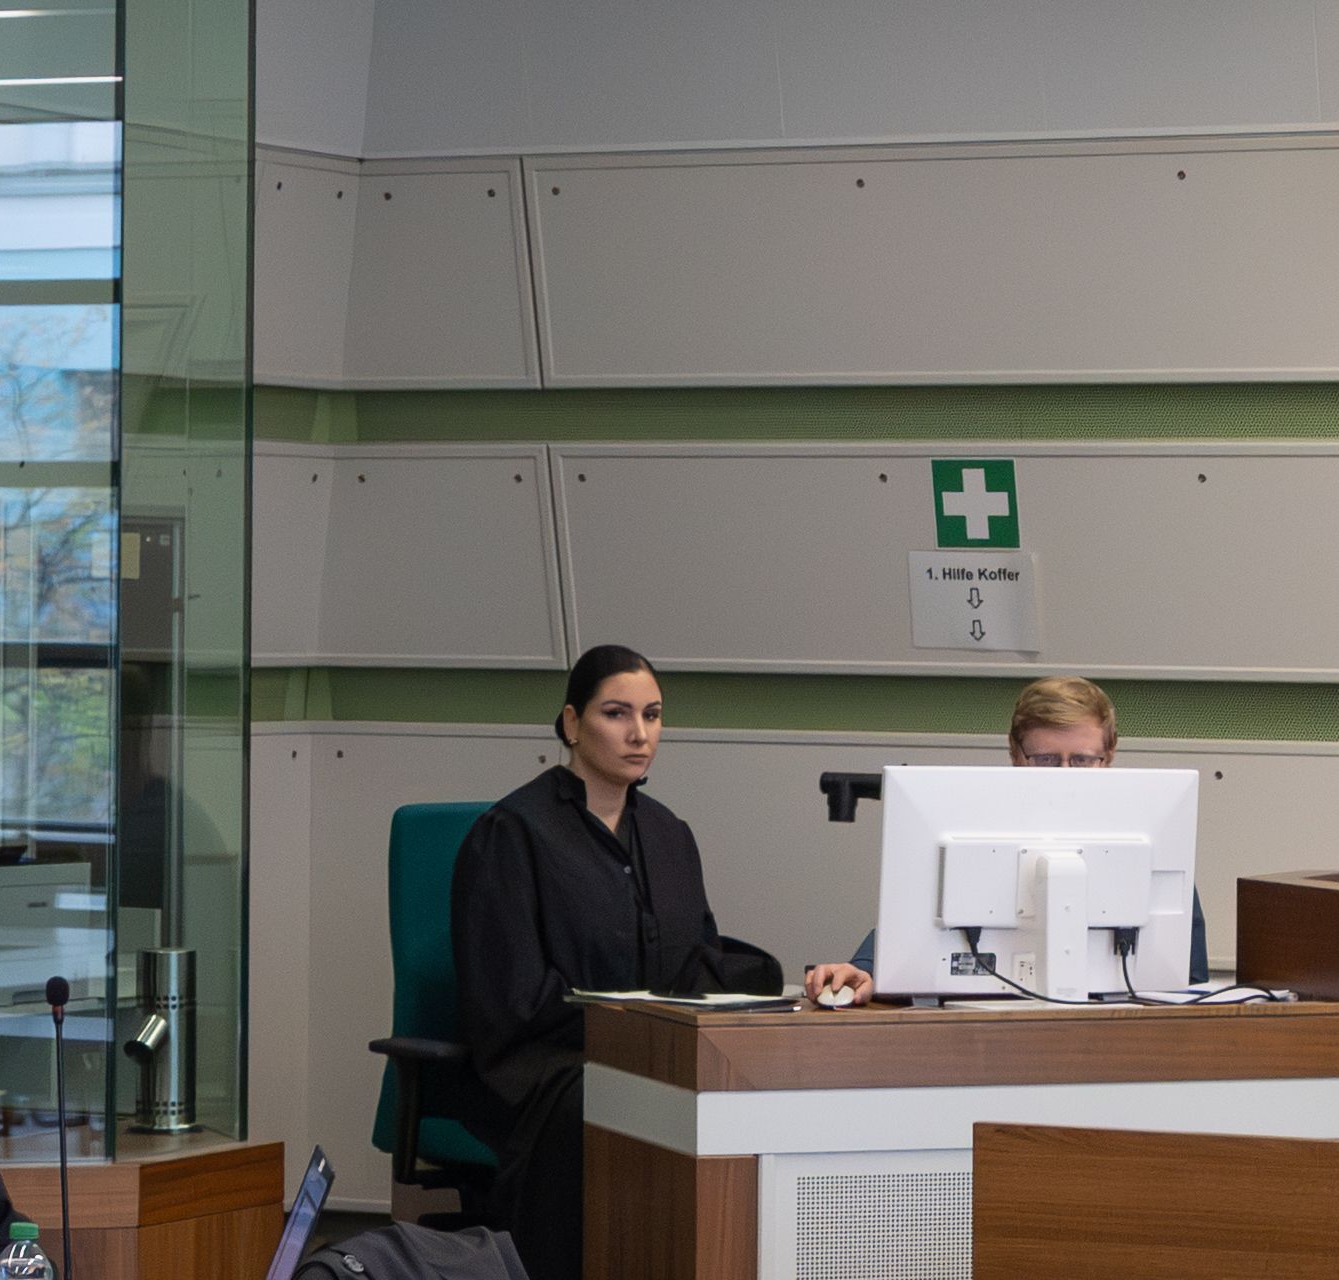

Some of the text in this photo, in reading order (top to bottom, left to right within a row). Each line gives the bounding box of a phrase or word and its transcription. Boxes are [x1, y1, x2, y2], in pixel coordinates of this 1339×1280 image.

[926, 567, 1019, 581] 1. Hilfe Koffer
